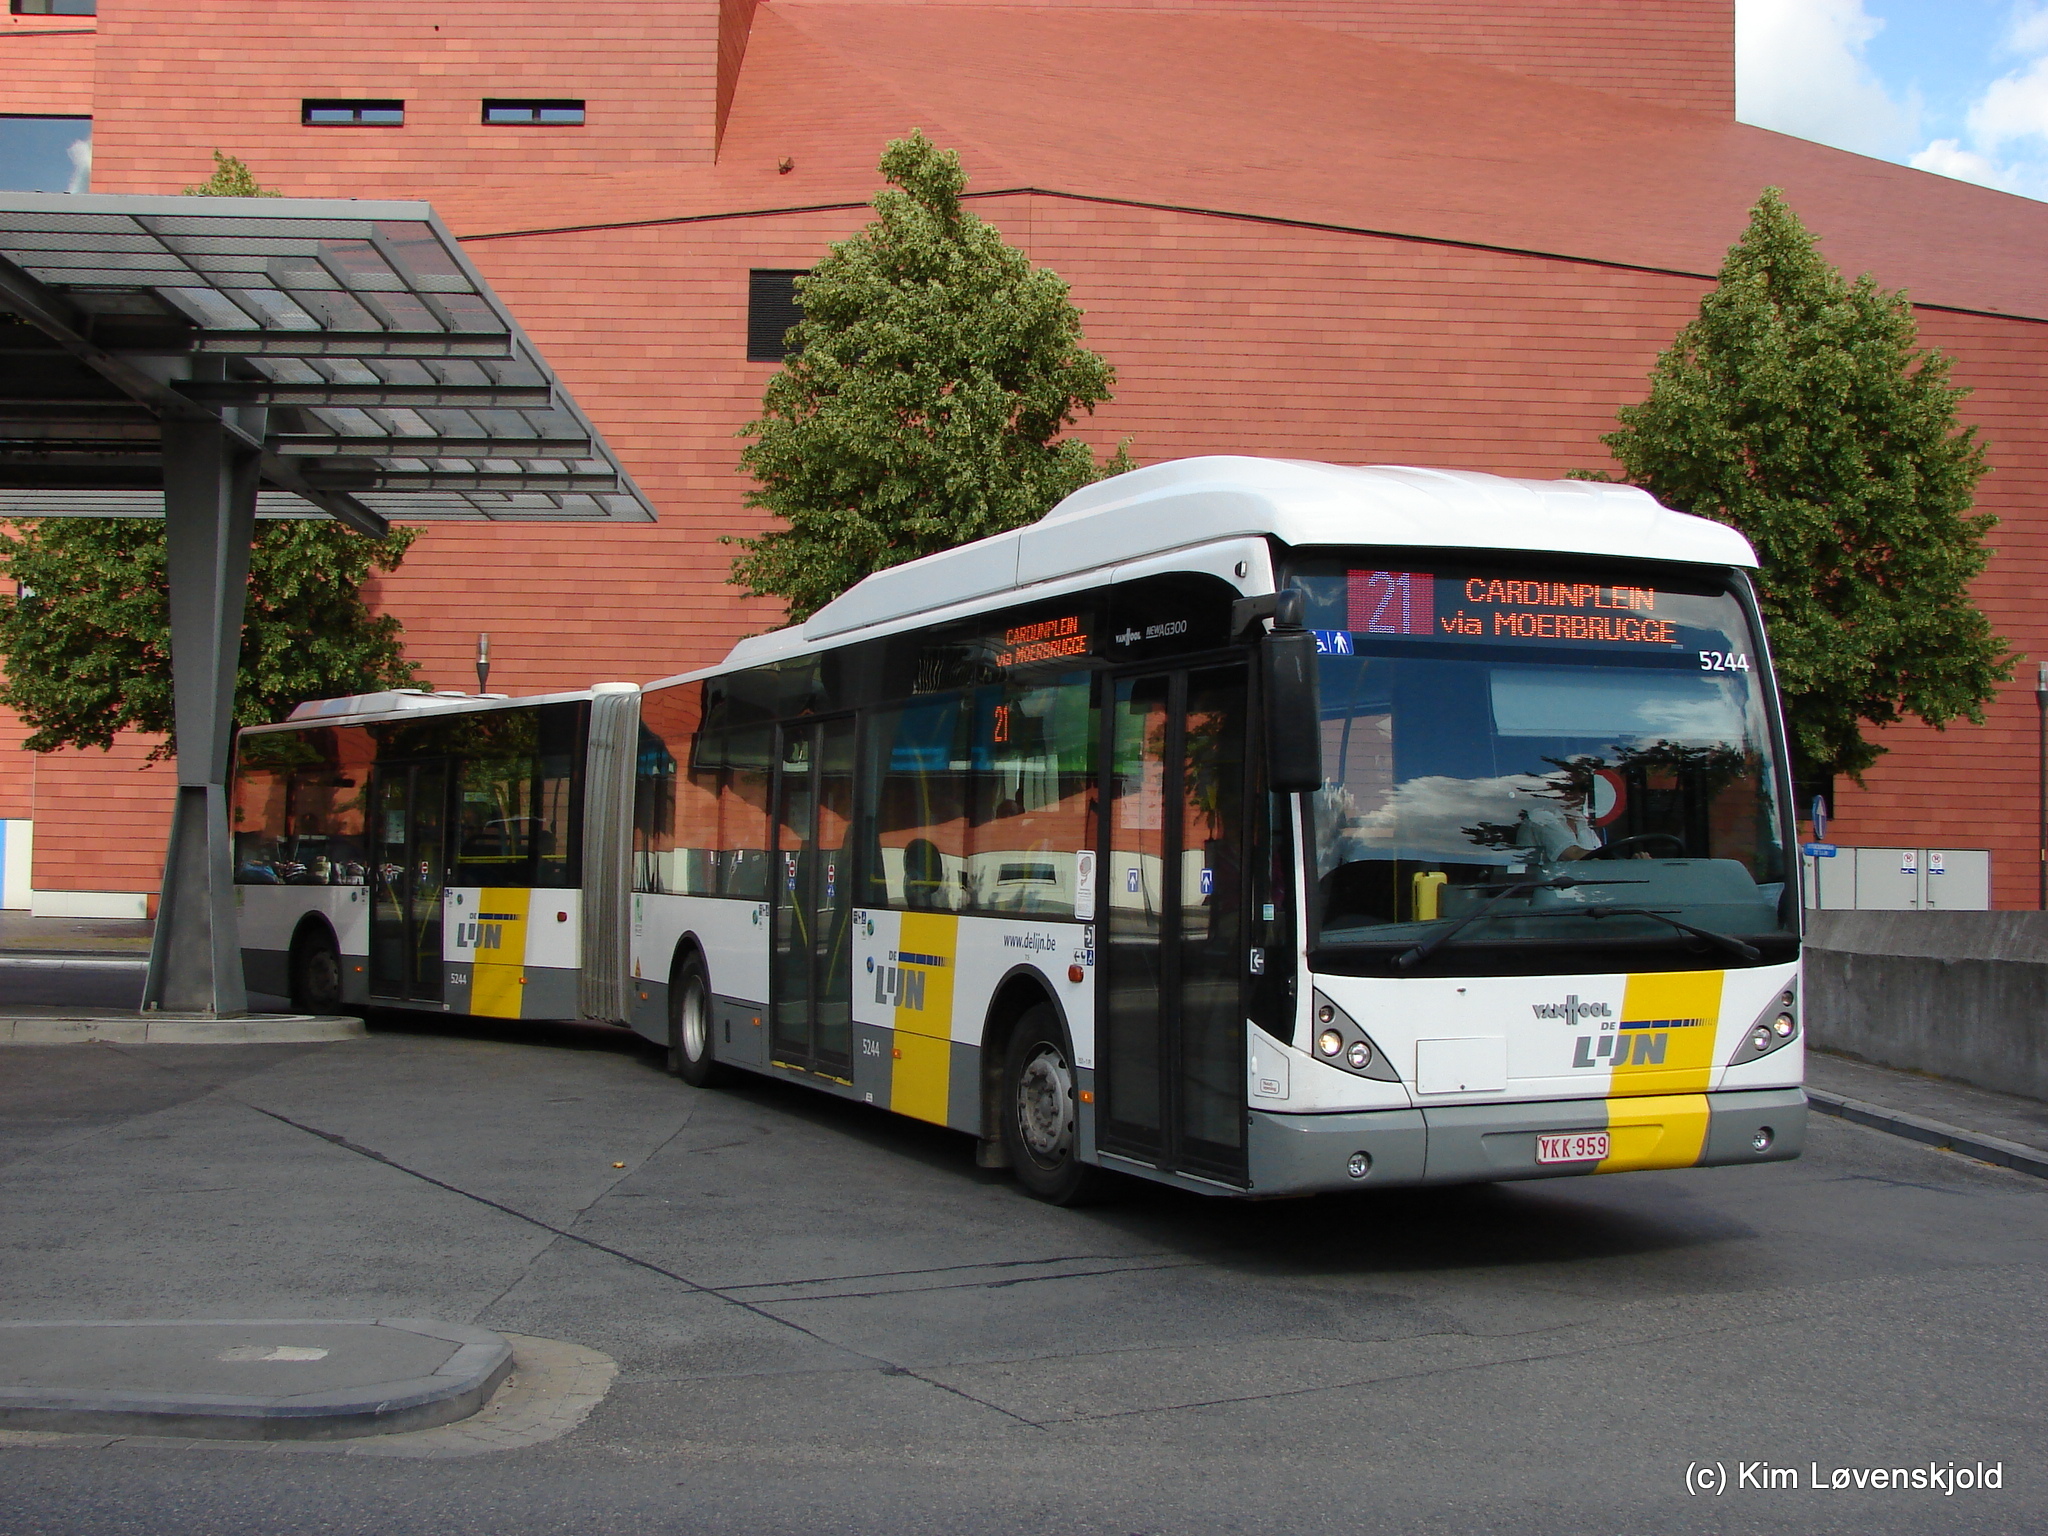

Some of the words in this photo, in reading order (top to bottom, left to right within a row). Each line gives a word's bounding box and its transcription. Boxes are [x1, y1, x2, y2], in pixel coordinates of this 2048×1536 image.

[1368, 571, 1410, 634] 21
[1465, 578, 1655, 611] CARDIJNPLEIN
[1440, 610, 1483, 635] via
[1494, 611, 1677, 643] MOERBRUGGE
[1015, 634, 1087, 664] MOERBRUGGE
[1699, 651, 1749, 672] 5244
[994, 705, 1008, 742] 21
[457, 923, 502, 948] LIJN
[1003, 931, 1056, 954] www.delijn.be
[888, 950, 897, 961] DE
[450, 972, 467, 984] 5244
[875, 965, 926, 1011] LIJN
[1600, 1021, 1616, 1030] DE
[862, 1038, 880, 1057] 5244
[1572, 1033, 1668, 1068] LIJN
[1541, 1136, 1607, 1158] YKK-959
